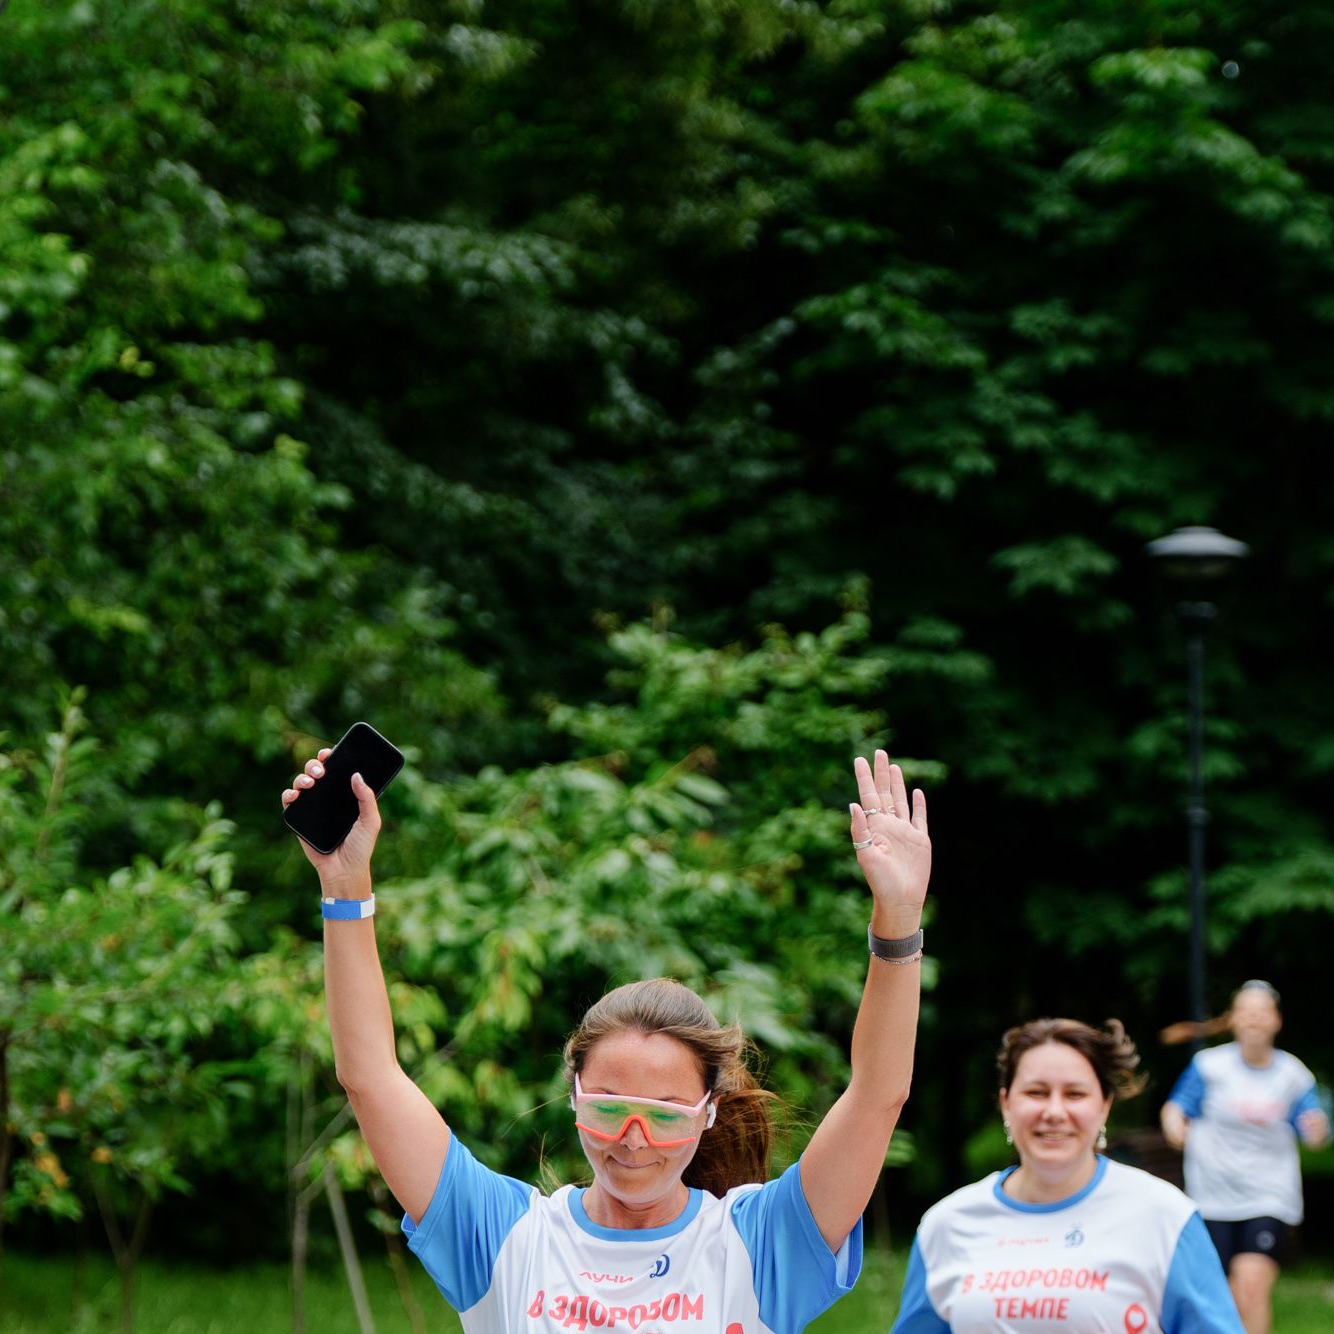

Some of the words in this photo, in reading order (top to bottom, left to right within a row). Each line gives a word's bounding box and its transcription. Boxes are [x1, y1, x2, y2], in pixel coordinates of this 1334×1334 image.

[962, 1273, 975, 1295] В
[979, 1268, 1110, 1292] ЗДОРОВОМ
[526, 1289, 546, 1319] В
[548, 1293, 704, 1331] ЗДОРОВОМ
[994, 1297, 1071, 1320] ТЕМПЕ
